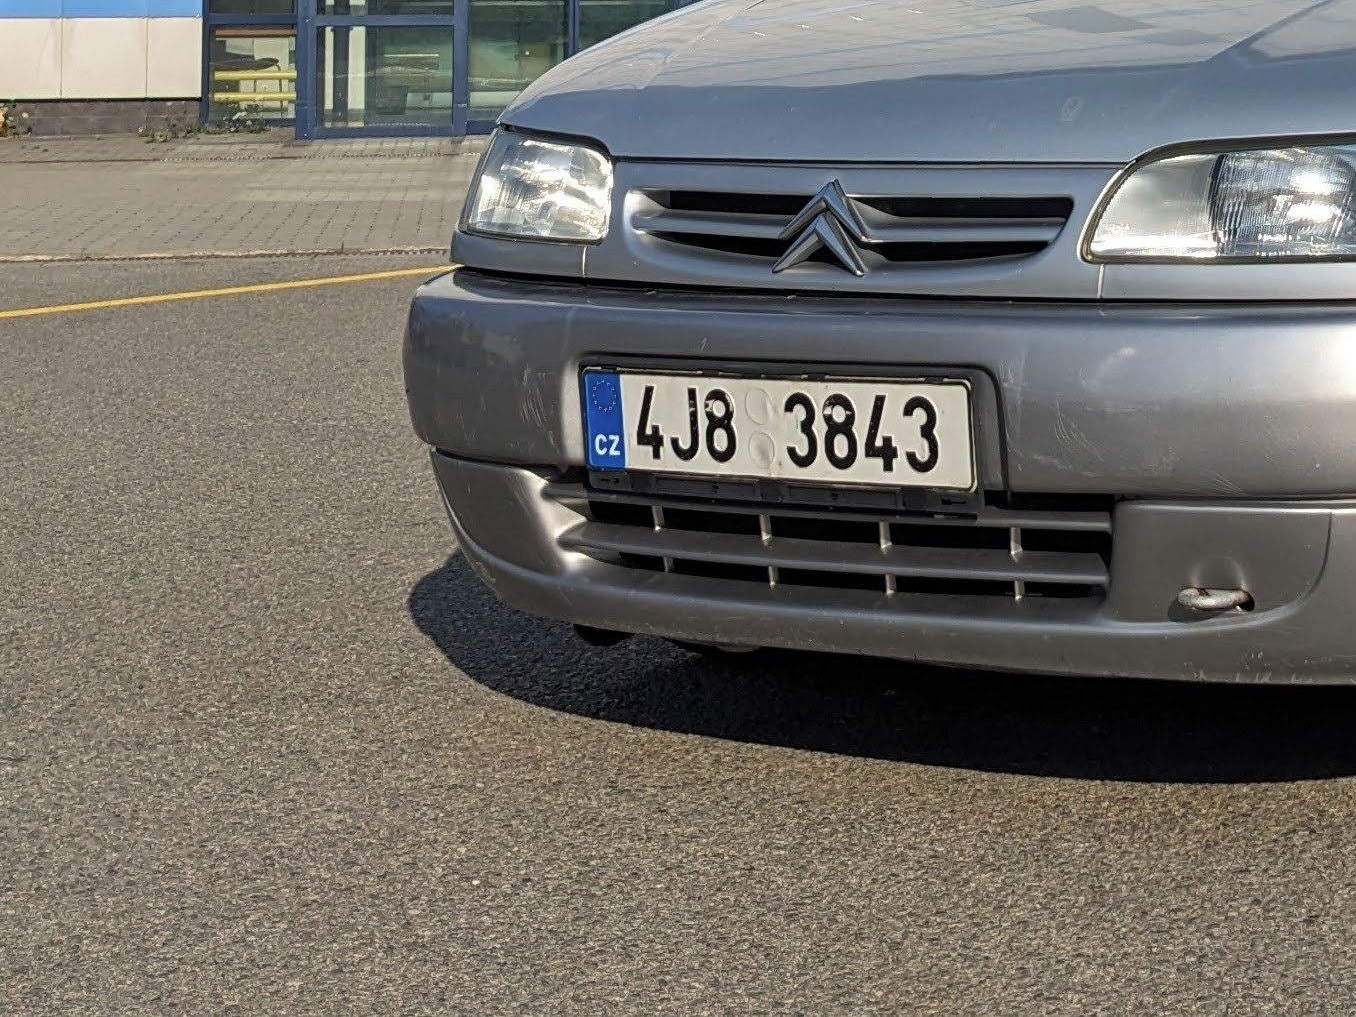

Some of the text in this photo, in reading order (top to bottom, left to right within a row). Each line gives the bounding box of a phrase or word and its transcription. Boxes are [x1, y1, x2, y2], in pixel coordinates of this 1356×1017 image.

[595, 434, 621, 457] CZ
[637, 385, 940, 473] 4J8 3843
